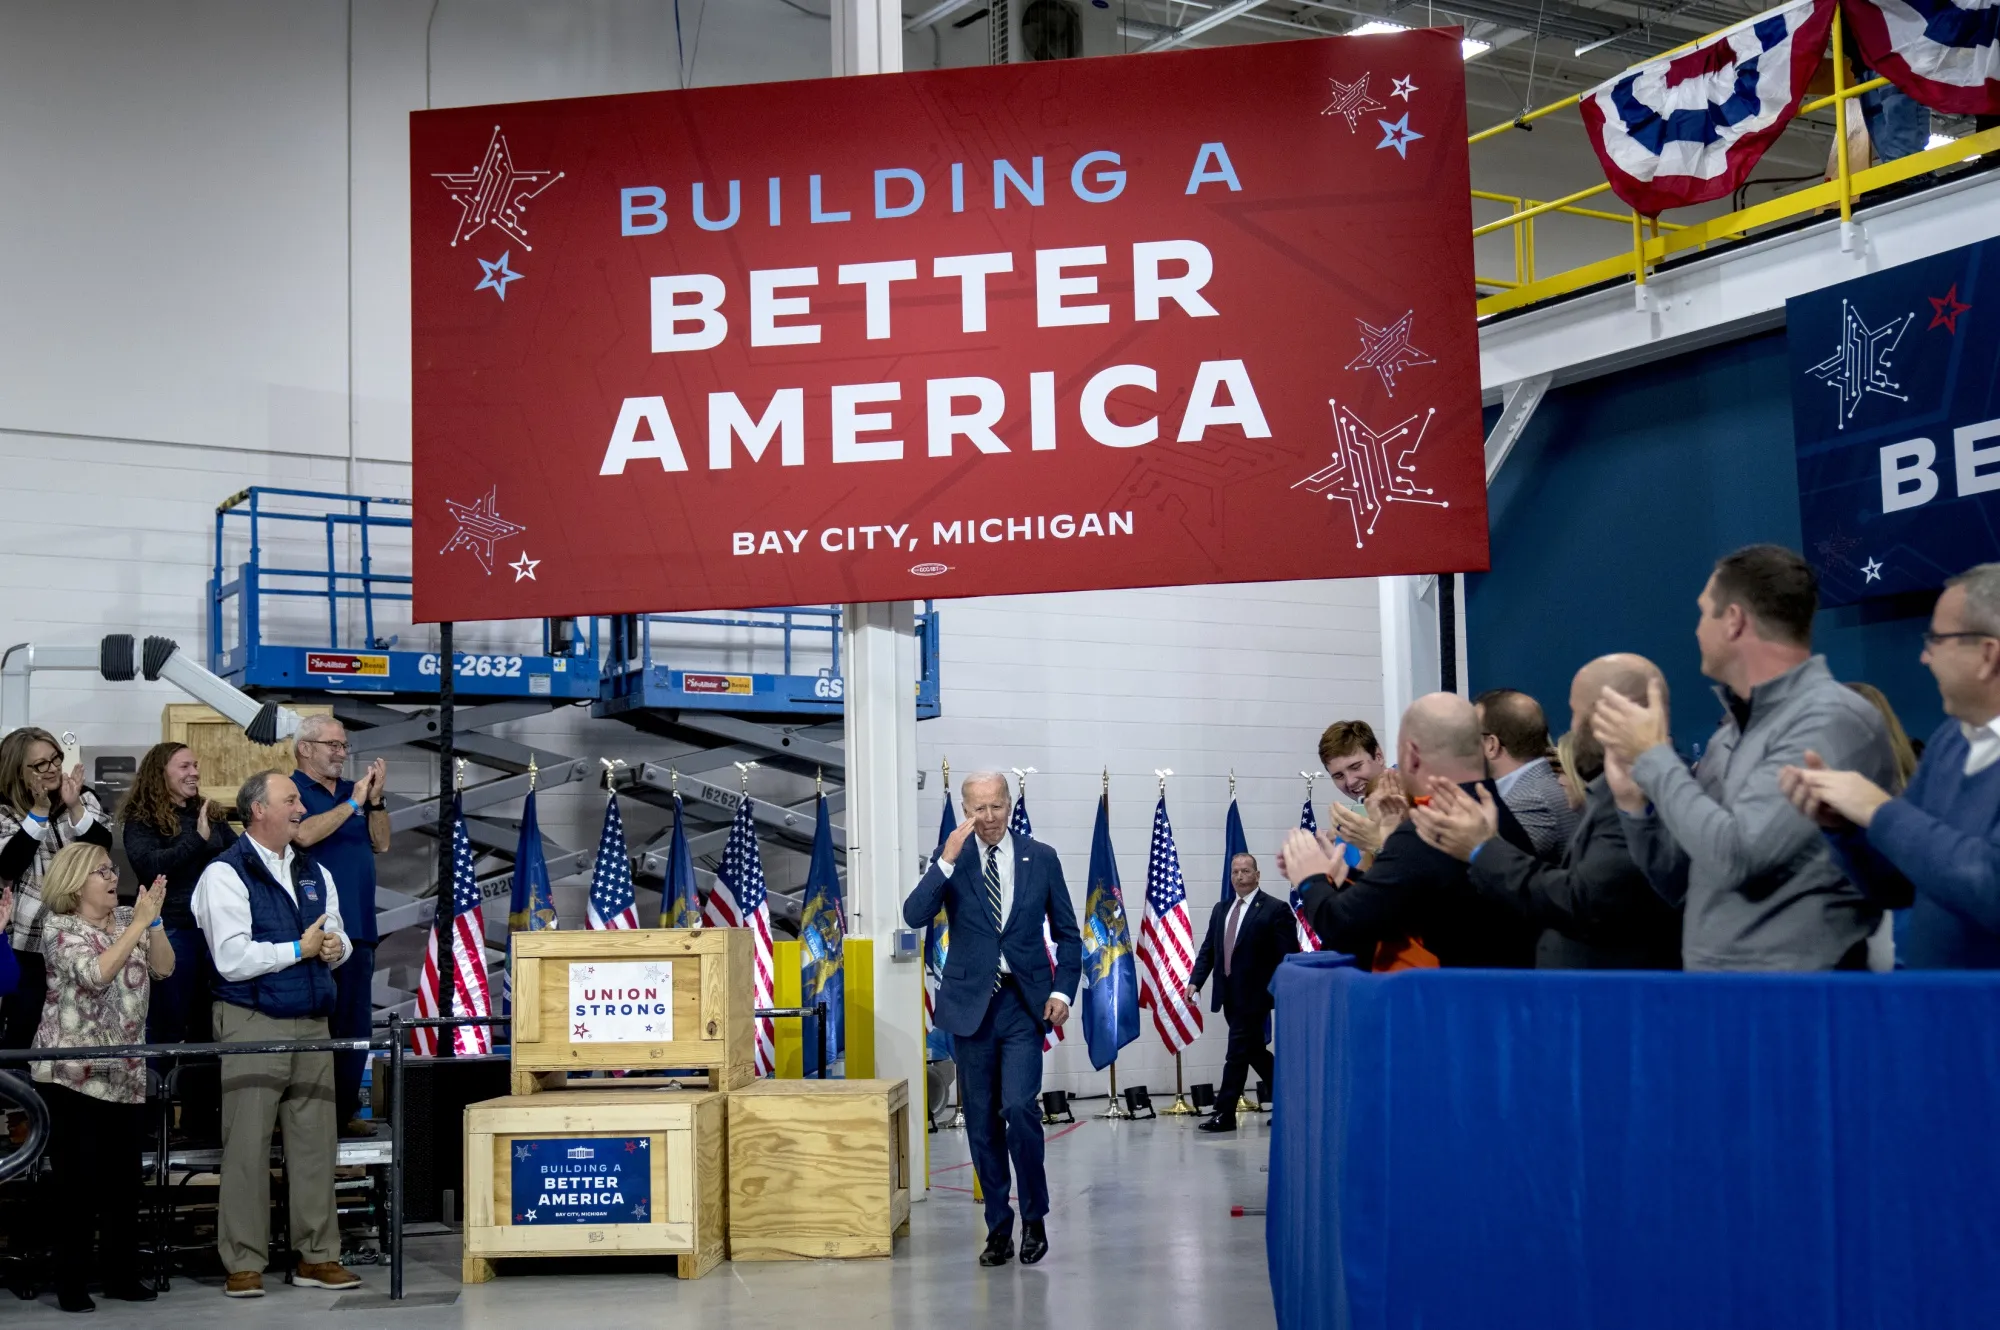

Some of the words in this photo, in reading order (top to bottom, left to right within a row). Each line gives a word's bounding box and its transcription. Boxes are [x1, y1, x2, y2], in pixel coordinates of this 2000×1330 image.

[622, 150, 1127, 237] BUILDING
[1184, 142, 1242, 195] A
[650, 239, 1221, 354] BETTER
[599, 358, 1272, 476] AMERICA
[732, 529, 809, 556] BAY
[820, 523, 919, 552] CITY,
[932, 510, 1135, 546] MICHIGAN
[584, 988, 657, 1001] UNION
[576, 1003, 666, 1016] STRONG
[541, 1164, 608, 1174] BUILDING
[613, 1164, 622, 1172] A
[544, 1176, 619, 1189] BETTER
[538, 1192, 625, 1206] AMERICA
